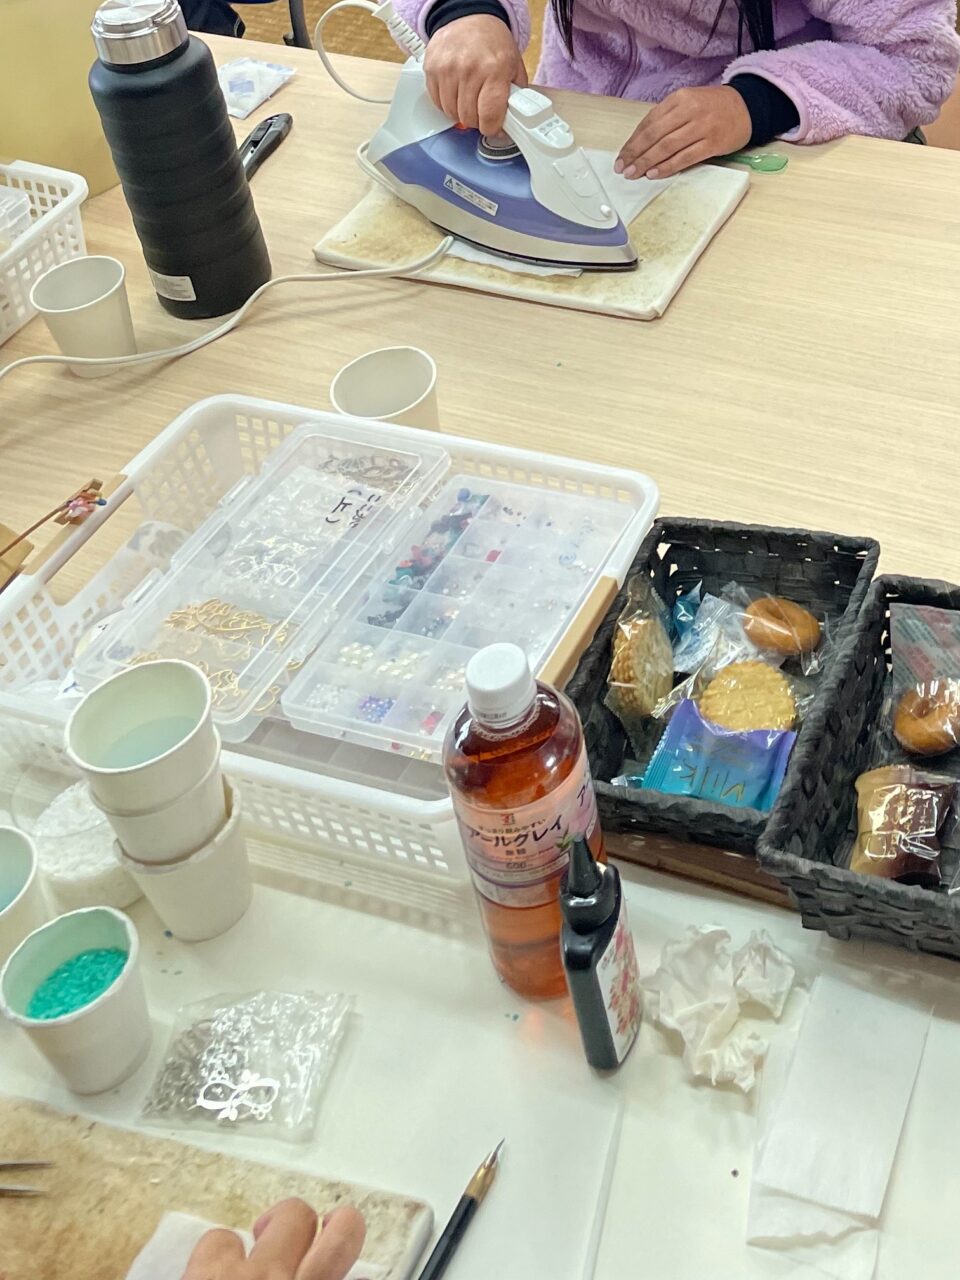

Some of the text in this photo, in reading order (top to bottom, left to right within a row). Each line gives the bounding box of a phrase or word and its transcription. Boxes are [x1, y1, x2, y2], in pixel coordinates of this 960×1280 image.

[469, 813, 563, 847] アールグレイ
